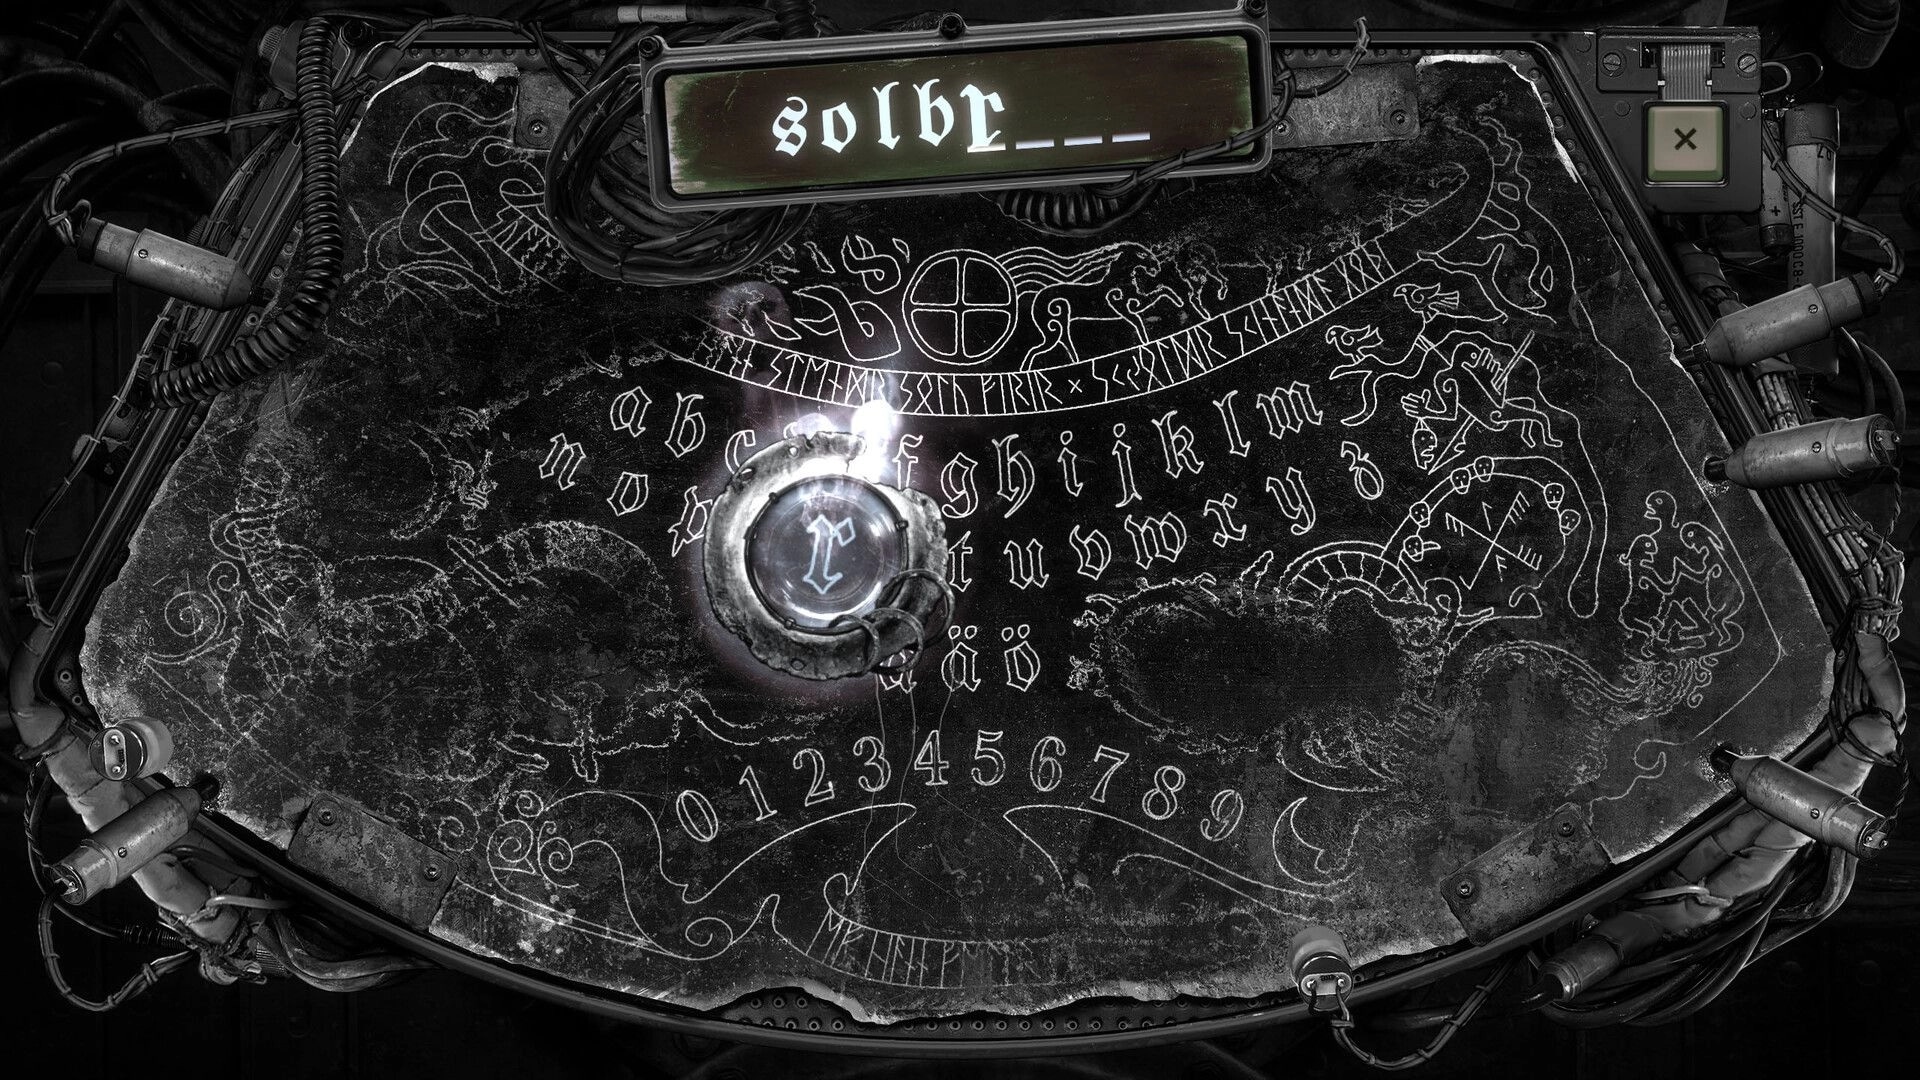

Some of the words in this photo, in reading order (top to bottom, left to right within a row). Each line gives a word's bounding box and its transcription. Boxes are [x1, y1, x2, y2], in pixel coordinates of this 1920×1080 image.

[538, 432, 587, 491] n
[606, 471, 649, 517] o
[1003, 538, 1050, 590] u
[1069, 524, 1112, 581] v
[1124, 511, 1187, 570] w
[1203, 492, 1247, 548] x
[1265, 466, 1316, 536] y
[1340, 440, 1384, 501] z
[610, 386, 652, 437] a
[664, 392, 706, 458] b
[941, 452, 979, 519] g
[991, 433, 1035, 519] h
[1057, 430, 1084, 497] i
[1111, 422, 1143, 508] j
[1151, 410, 1205, 479] k
[1212, 389, 1251, 458] l
[1255, 380, 1324, 440] m
[940, 625, 982, 692] ä
[1001, 624, 1041, 693] ö
[675, 789, 719, 842] 0
[739, 765, 778, 822] 1
[792, 748, 835, 807] 2
[853, 736, 892, 793] 3
[914, 729, 949, 786] 4
[972, 729, 1004, 786] 5
[1030, 736, 1066, 792] 6
[1092, 744, 1130, 803] 7
[1141, 765, 1186, 821] 8
[1200, 789, 1244, 841] 9
